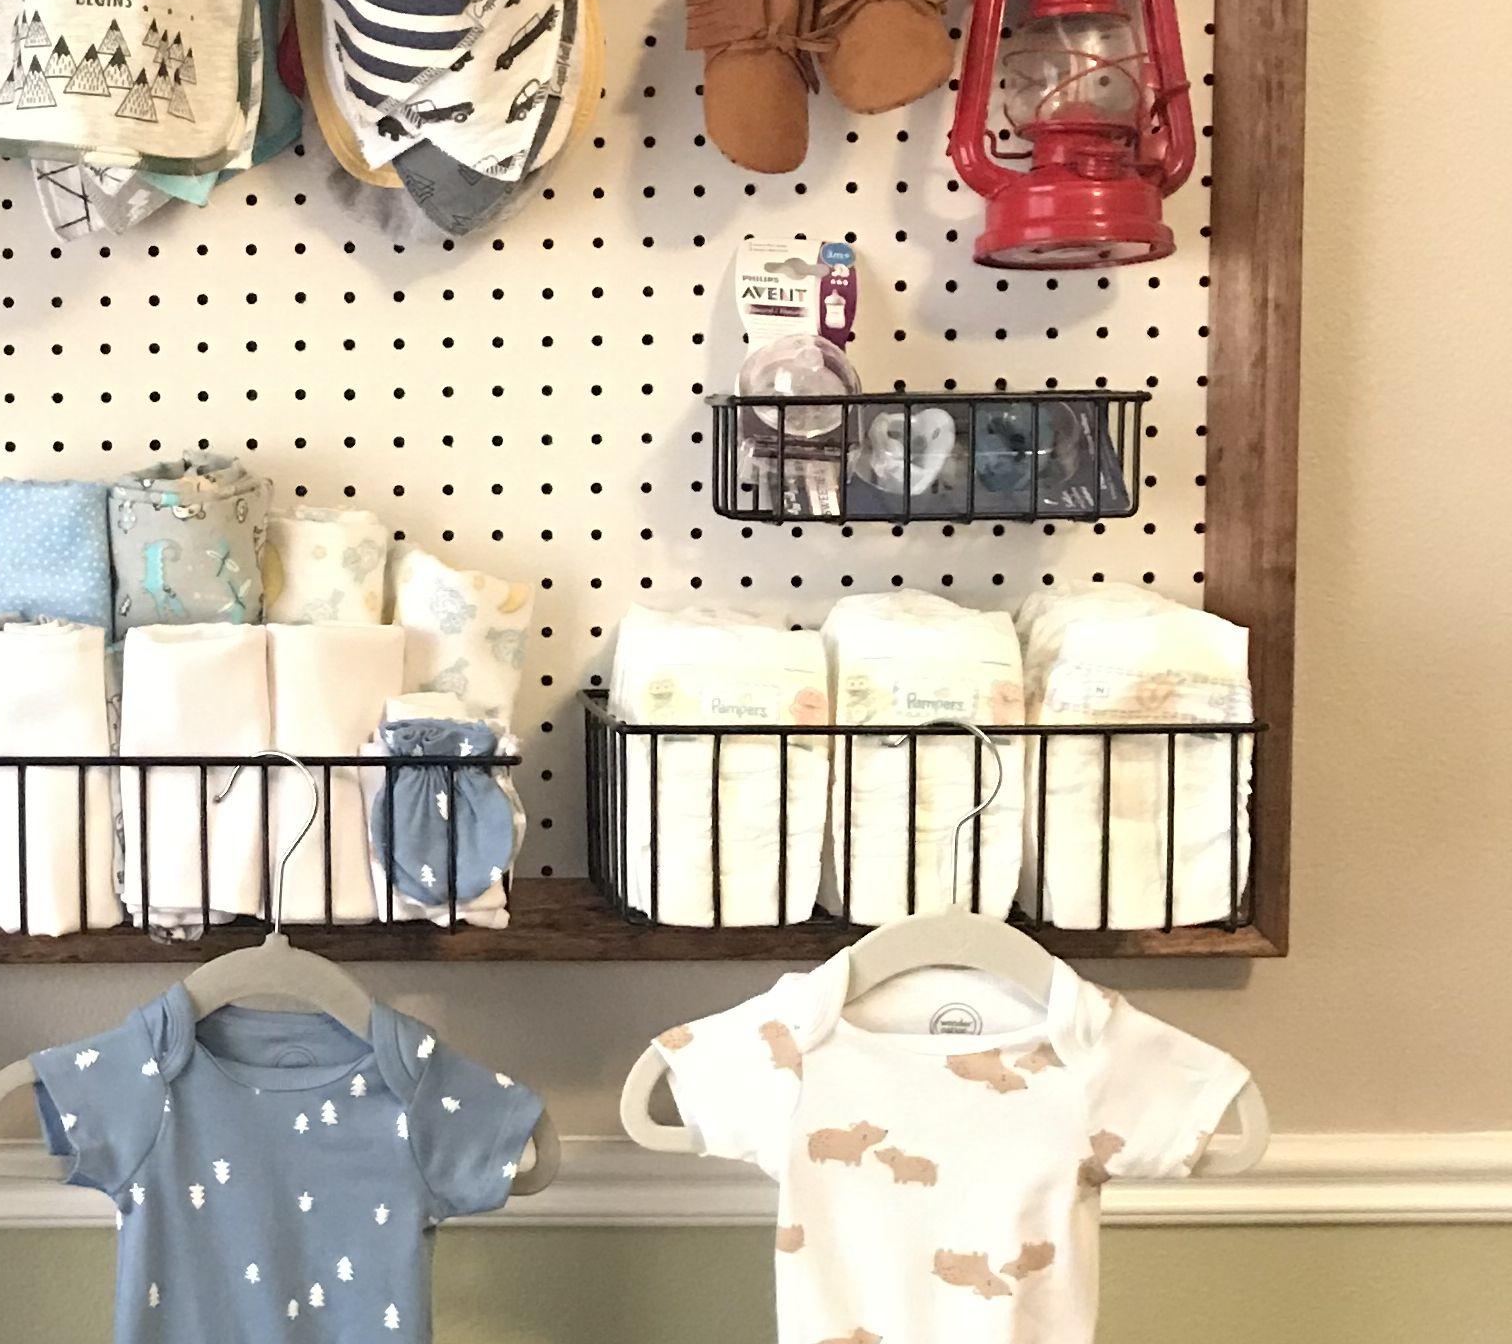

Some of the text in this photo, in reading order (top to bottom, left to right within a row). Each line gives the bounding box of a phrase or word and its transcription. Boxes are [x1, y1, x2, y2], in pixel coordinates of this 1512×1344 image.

[741, 285, 808, 303] AVENT
[711, 696, 768, 720] Pampers
[906, 691, 966, 712] Pampers
